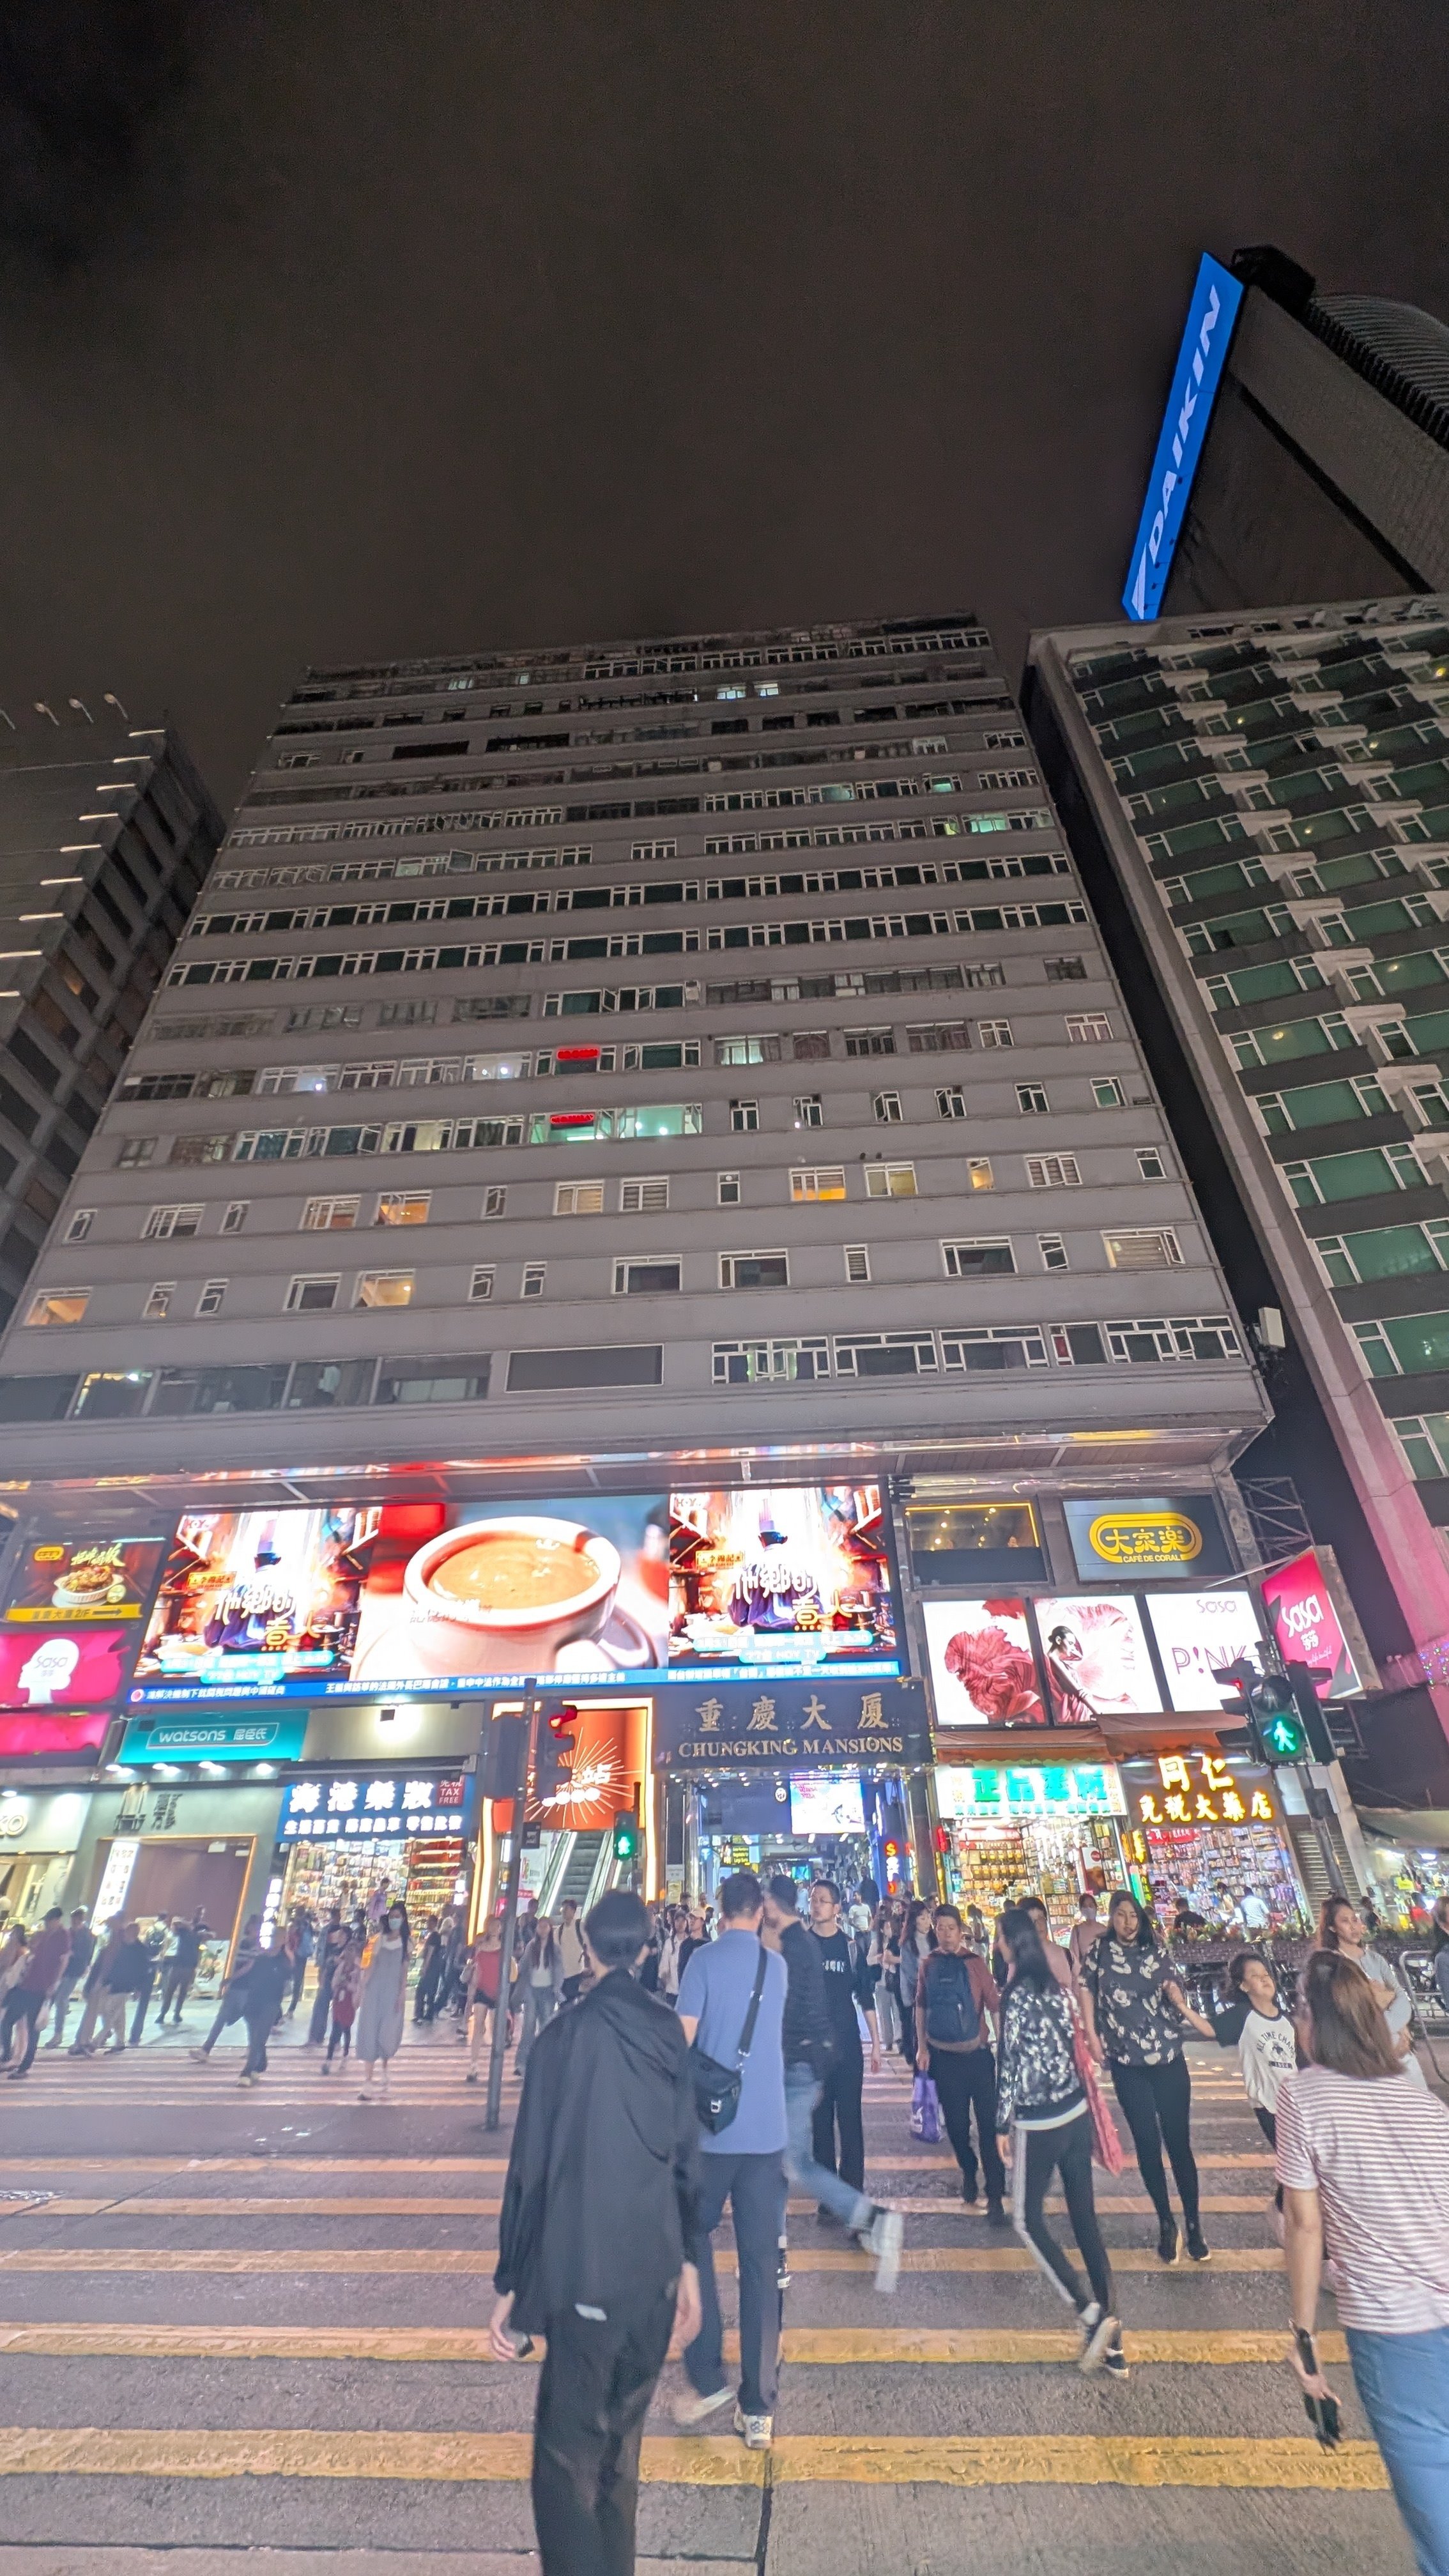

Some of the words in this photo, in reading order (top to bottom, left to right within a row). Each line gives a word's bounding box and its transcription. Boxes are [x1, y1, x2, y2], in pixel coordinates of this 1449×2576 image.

[1149, 284, 1220, 565] DAIKIN
[1155, 1554, 1181, 1562] CORAL
[160, 1729, 226, 1742] watsons
[233, 1728, 268, 1740] 屈臣氏
[678, 1739, 798, 1758] CHUNGKING
[802, 1736, 903, 1755] MANSIONS
[1158, 1756, 1234, 1791] 同仁
[1256, 2039, 1266, 2053] ALL
[1261, 2032, 1276, 2042] TIME
